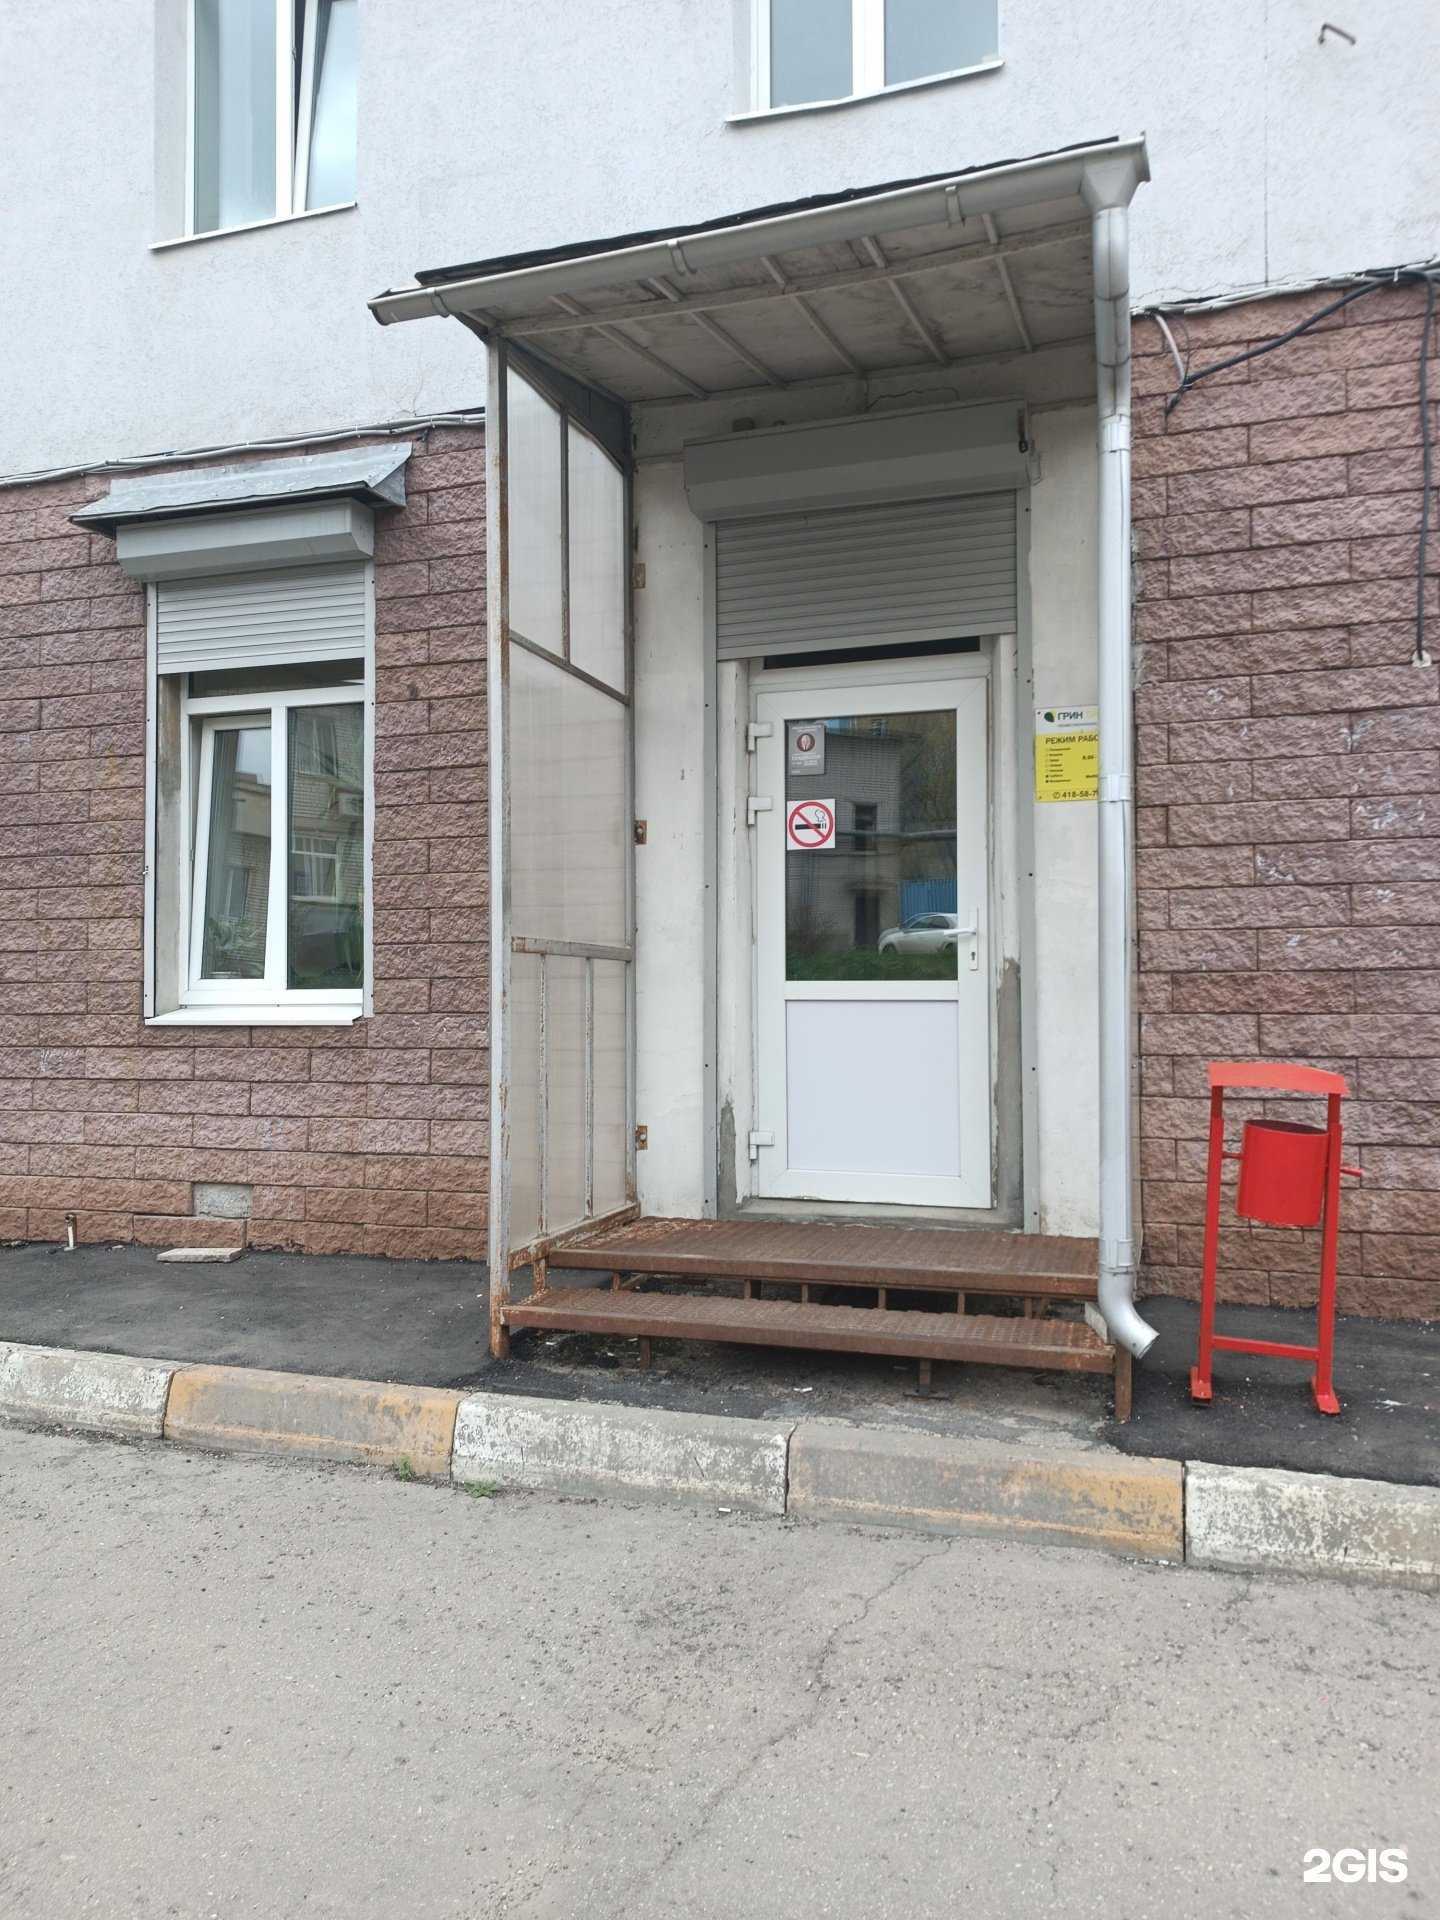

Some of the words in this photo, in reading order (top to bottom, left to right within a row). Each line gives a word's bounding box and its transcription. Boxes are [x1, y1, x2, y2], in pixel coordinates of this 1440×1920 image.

[1058, 711, 1083, 720] ГРИН
[1045, 736, 1076, 744] РЕЖИМ
[1061, 790, 1098, 798] 418-58-7
